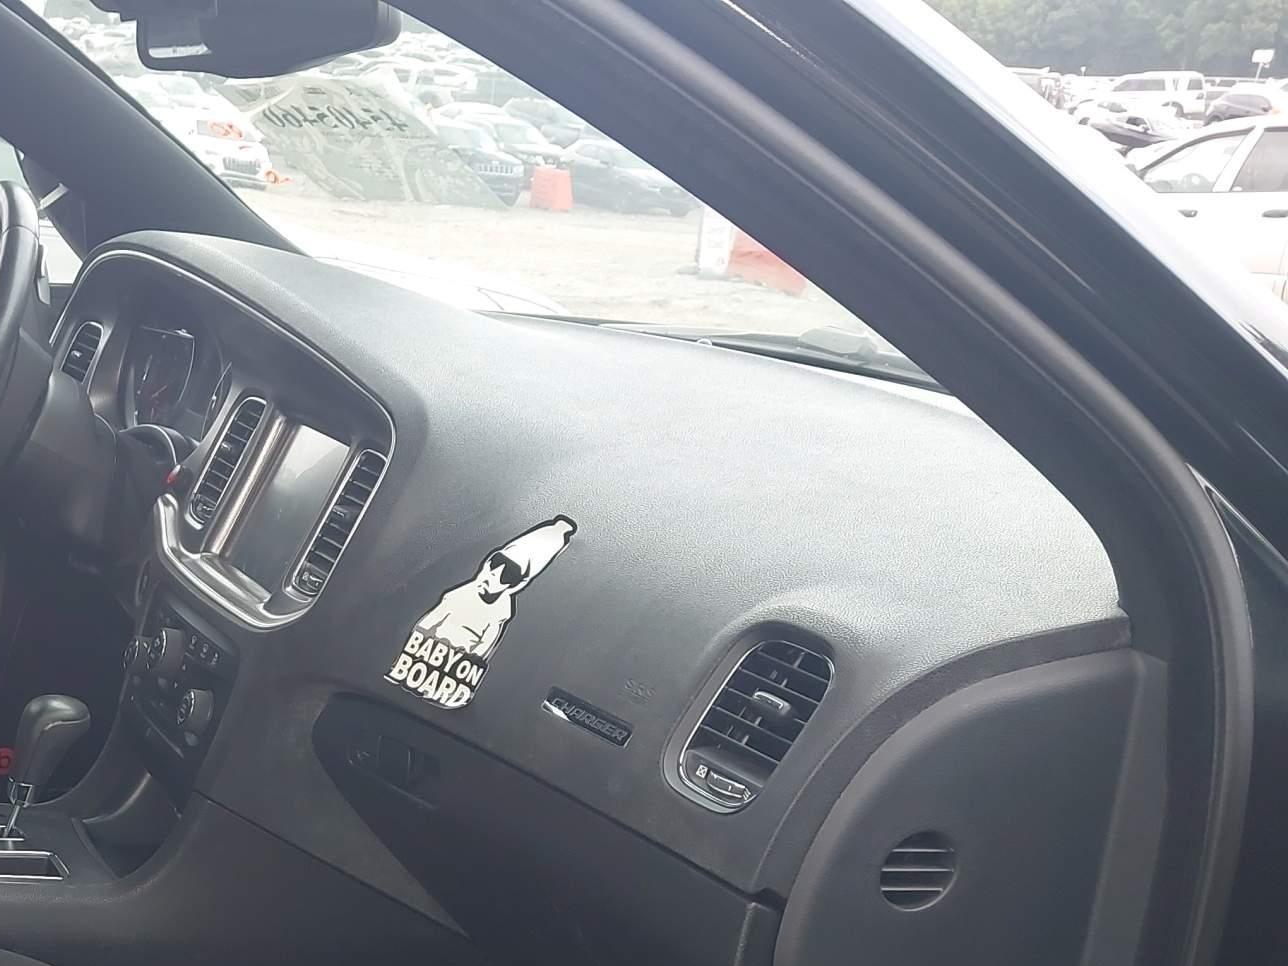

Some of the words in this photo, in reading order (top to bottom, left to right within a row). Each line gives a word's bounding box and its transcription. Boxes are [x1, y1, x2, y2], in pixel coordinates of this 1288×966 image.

[389, 653, 472, 707] BOARD
[404, 630, 464, 673] BABY
[456, 660, 485, 687] ON
[550, 696, 628, 742] CHARGER
